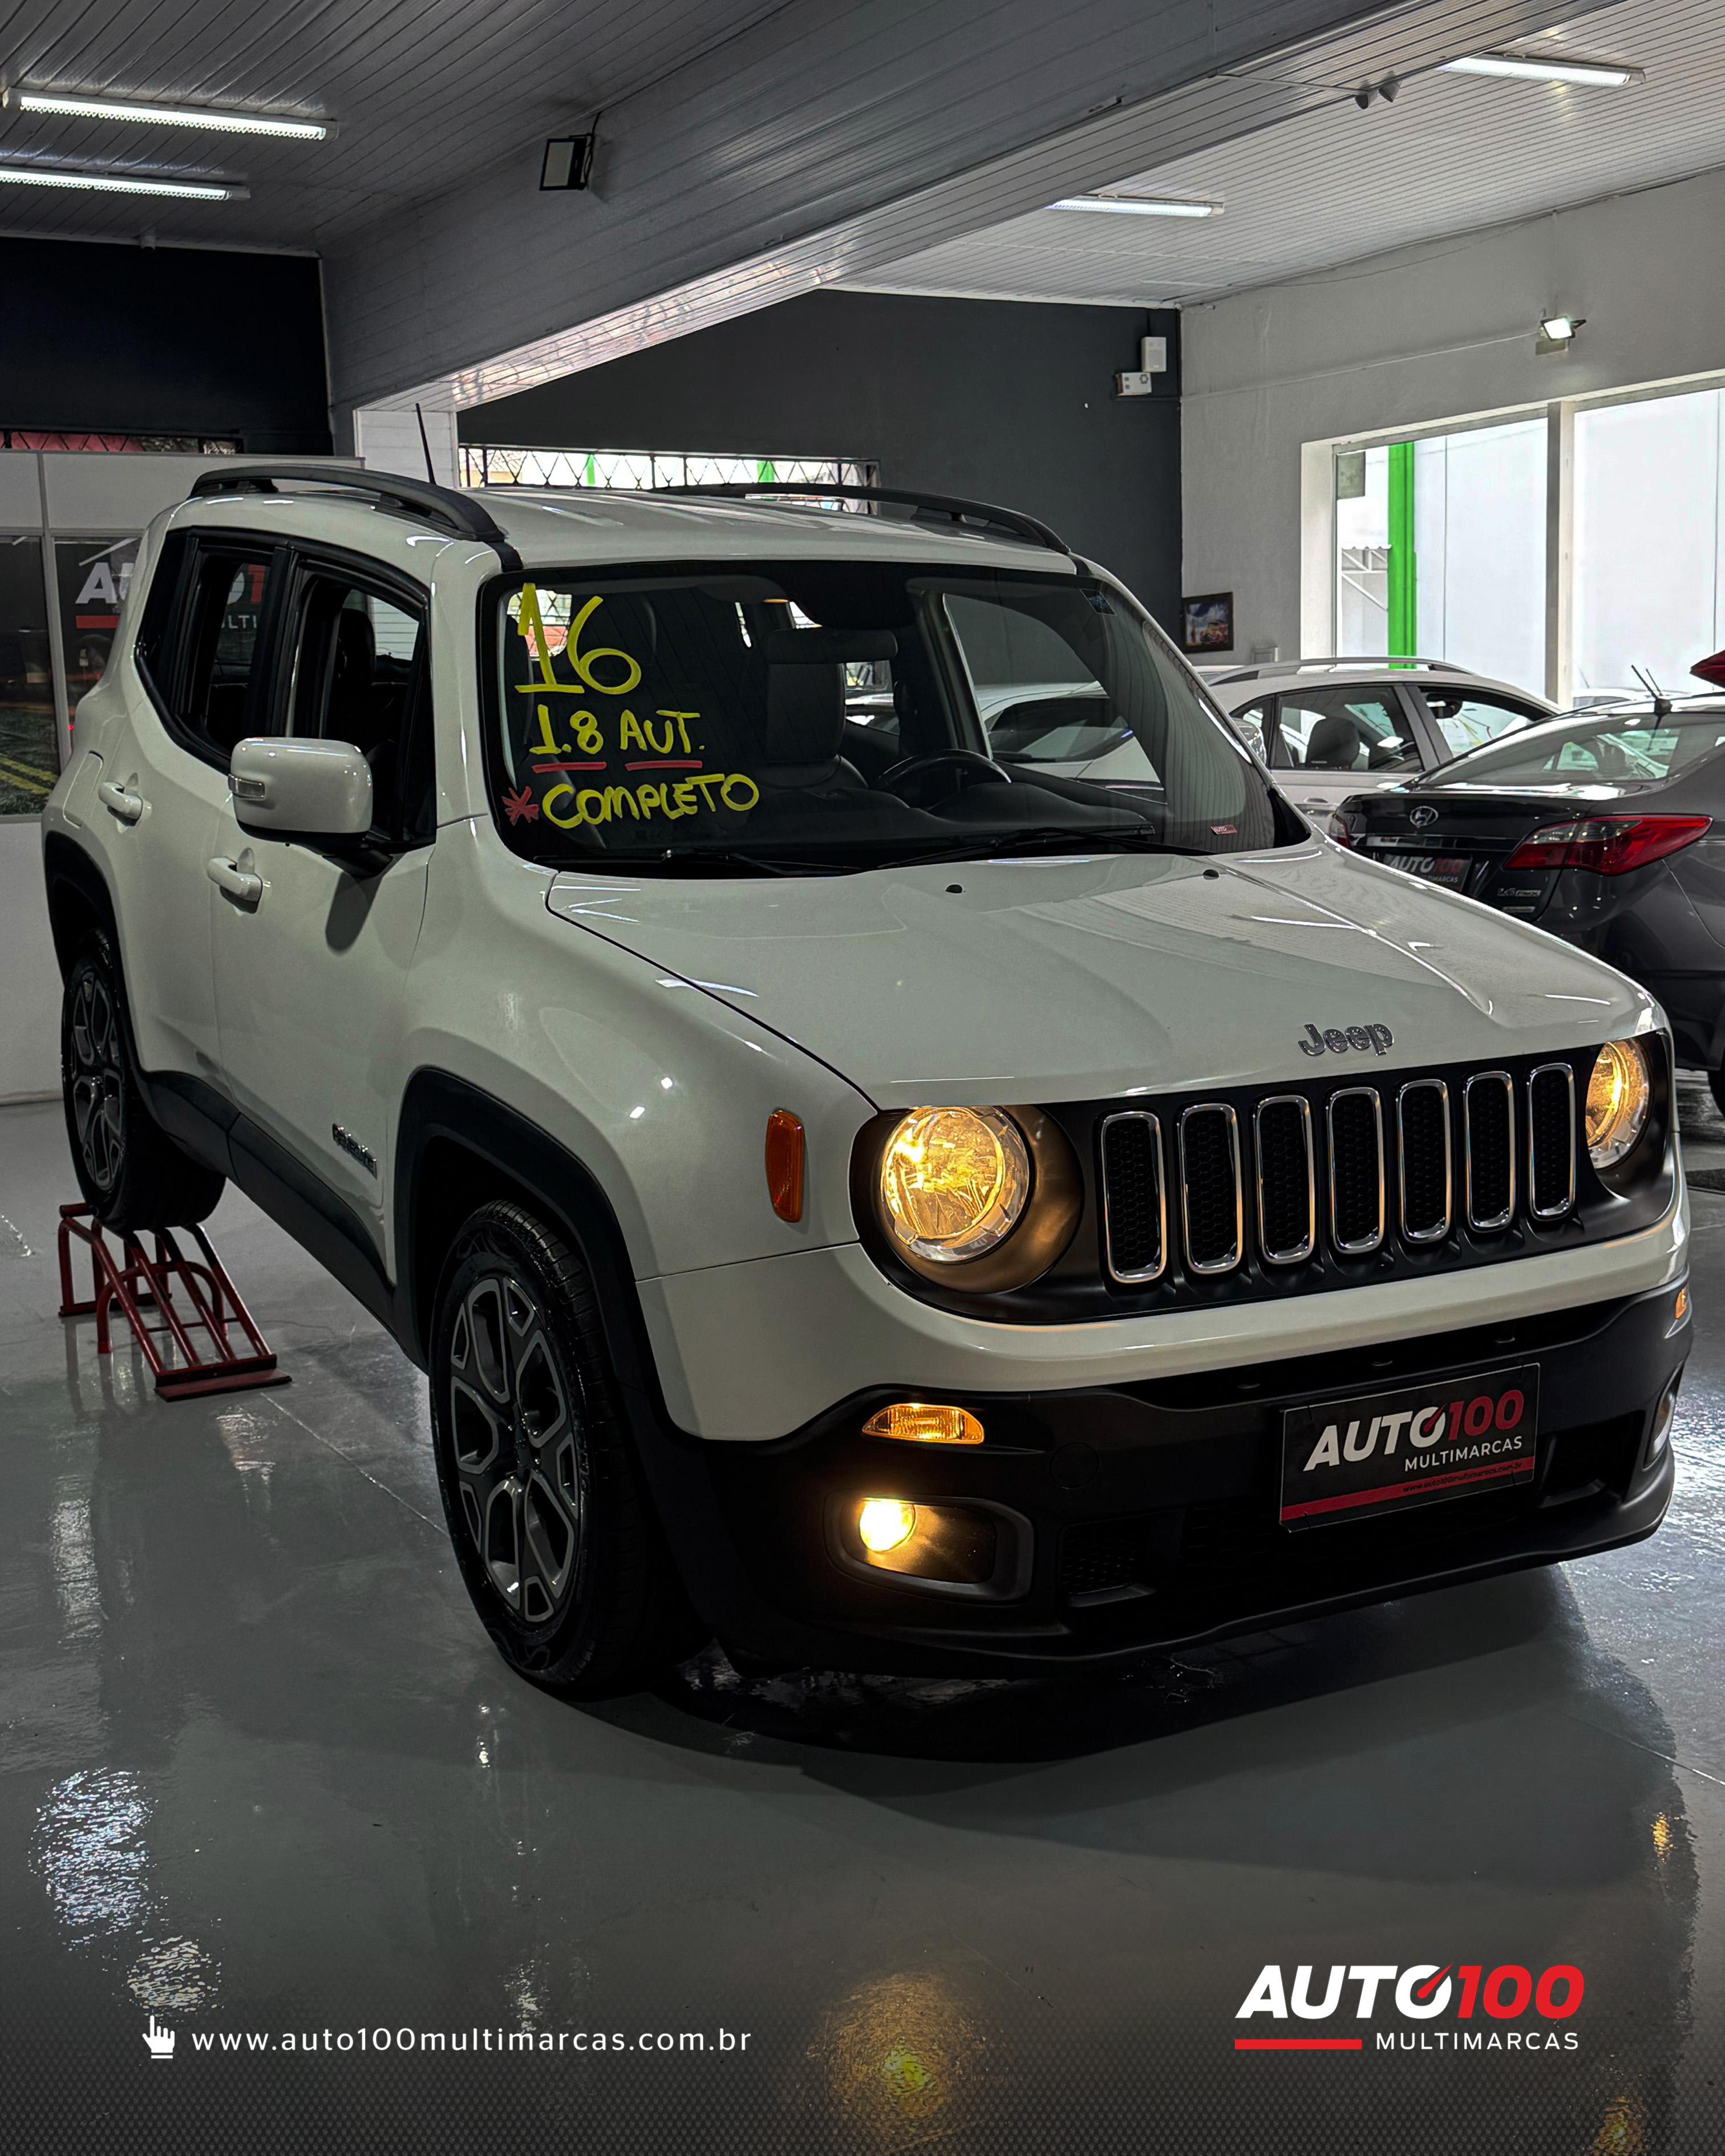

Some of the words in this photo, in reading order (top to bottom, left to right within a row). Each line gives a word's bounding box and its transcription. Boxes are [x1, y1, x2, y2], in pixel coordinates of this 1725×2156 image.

[515, 582, 642, 695] 16
[529, 704, 604, 755] 1.8
[619, 709, 706, 754] AUT.
[542, 773, 760, 829] COMPLETO
[1298, 1024, 1395, 1056] Jeep
[1303, 1389, 1524, 1472] AUTO100
[1404, 1436, 1522, 1472] MULTIMARCAS
